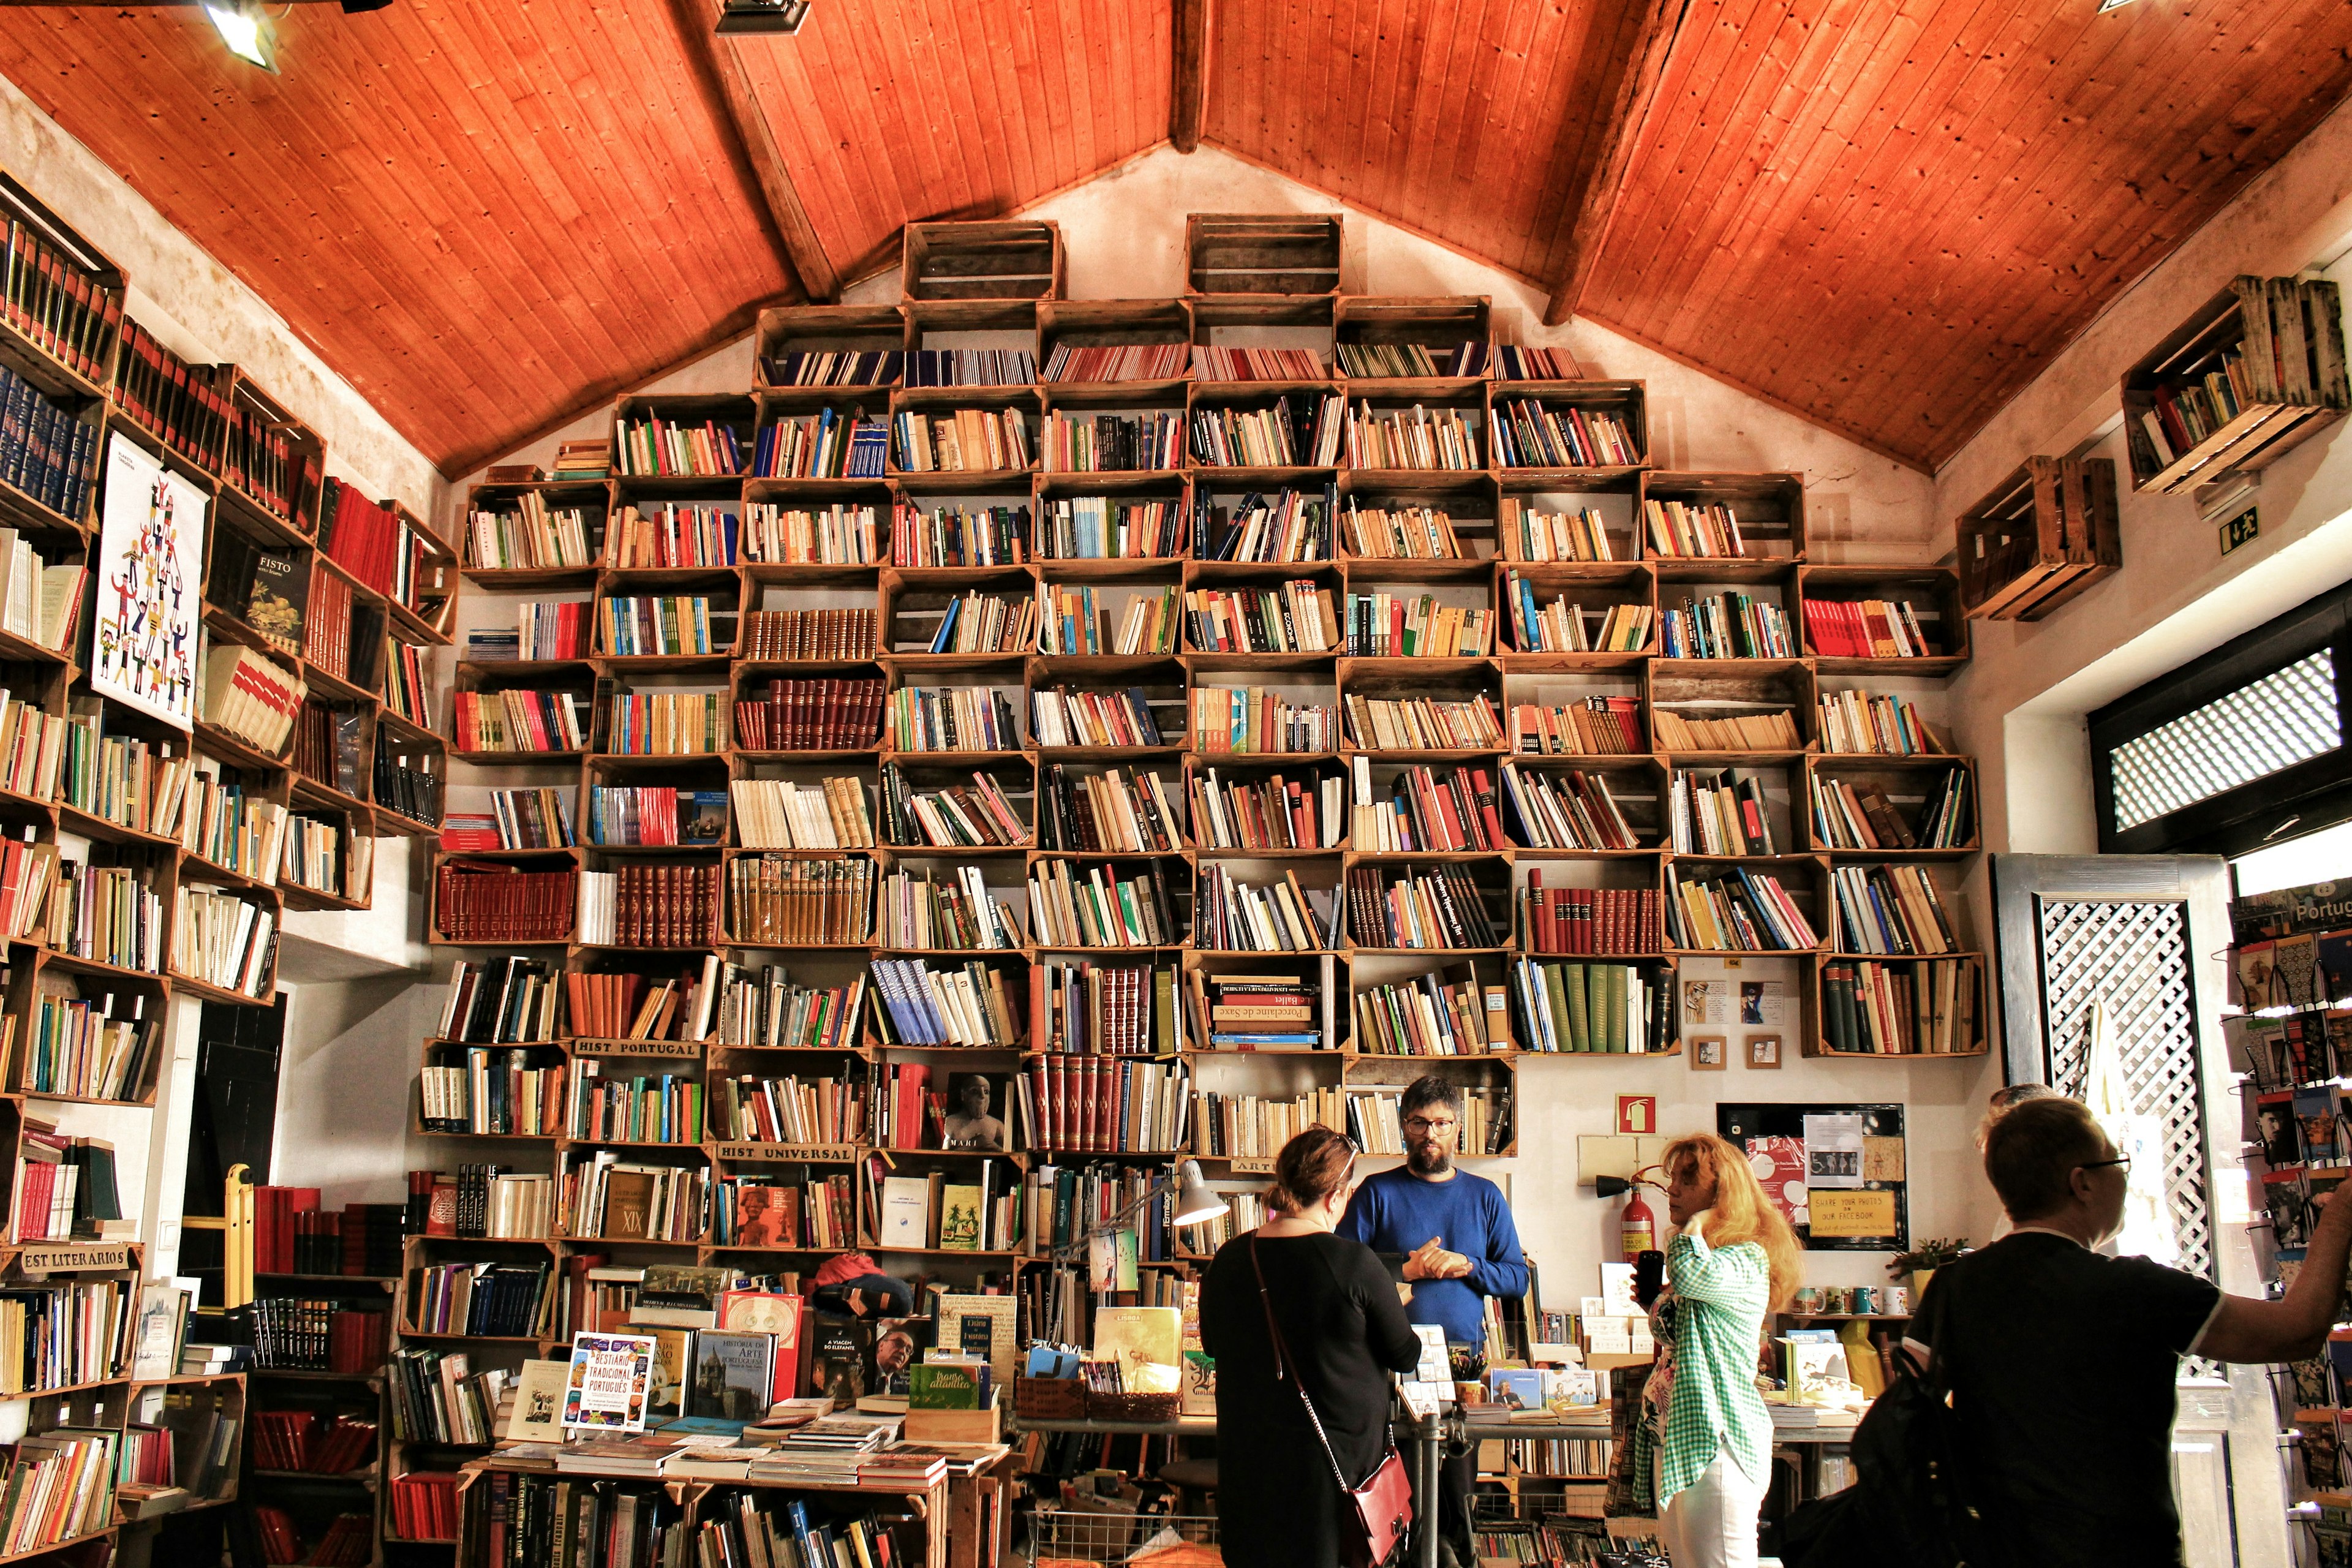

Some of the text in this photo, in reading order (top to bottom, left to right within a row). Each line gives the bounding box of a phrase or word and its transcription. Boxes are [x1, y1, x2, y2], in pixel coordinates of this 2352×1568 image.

[1284, 612, 1294, 643] ECONOMIA
[1275, 997, 1298, 1006] Ballet
[1219, 1009, 1303, 1019] Porcelaine de Saxe
[579, 1042, 695, 1055] HIST. PORTUGAL
[722, 1147, 850, 1161] HIST. UNIVERSAL
[489, 1164, 497, 1176] LE
[1815, 1199, 1836, 1208] SHARE
[622, 1210, 644, 1232] XIX
[25, 1248, 124, 1268] EST. LITERÁRIOS
[595, 1353, 629, 1366] BESTIÁRIO
[739, 1348, 763, 1358] ARTE
[589, 1366, 631, 1379] TRADICIONAL
[589, 1379, 627, 1393] PORTUGUÊS
